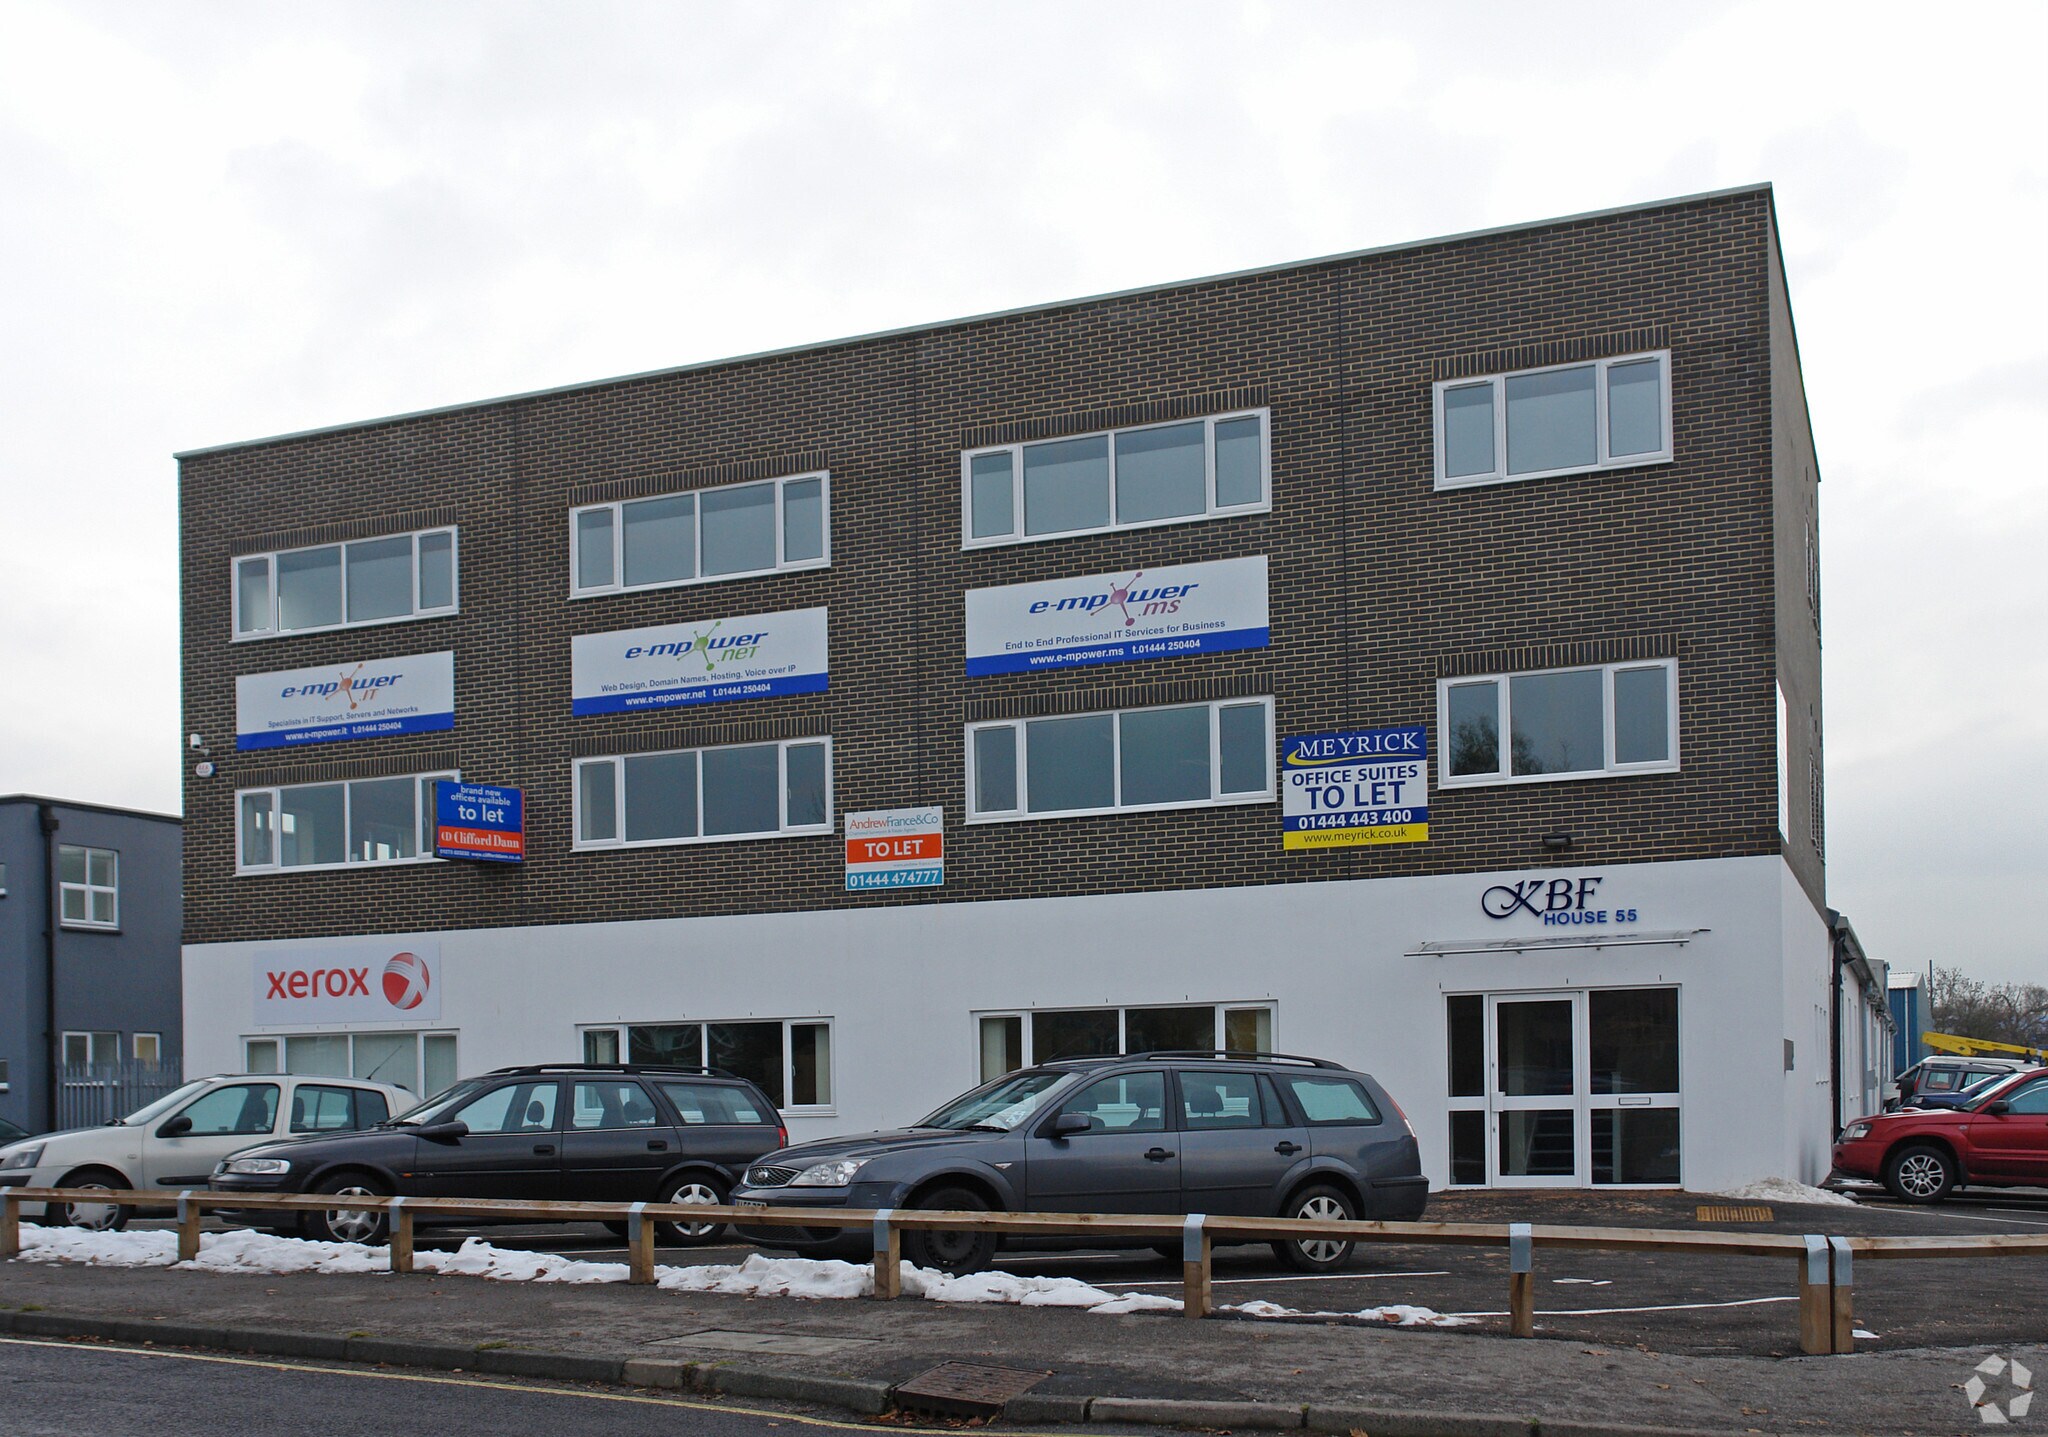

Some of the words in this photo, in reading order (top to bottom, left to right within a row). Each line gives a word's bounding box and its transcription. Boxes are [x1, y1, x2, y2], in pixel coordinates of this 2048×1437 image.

[1005, 641, 1023, 650] End
[1024, 640, 1034, 648] to
[1036, 638, 1054, 647] End
[1056, 631, 1113, 645] Professional
[1114, 630, 1123, 639] IT
[1125, 626, 1165, 638] Services
[1166, 624, 1181, 633] for
[1182, 619, 1226, 631] Business
[1029, 647, 1125, 665] www.e-mpower.ms
[1132, 641, 1166, 654] t.01444
[1167, 638, 1201, 650] 250404
[601, 683, 618, 693] Web
[619, 680, 648, 691] Design,
[649, 677, 679, 687] Domain
[680, 674, 709, 684] Names,
[710, 671, 744, 683] Hosting,
[744, 668, 767, 678] Voice
[768, 666, 787, 674] over
[787, 664, 797, 673] IP
[625, 689, 707, 706] www.e-mpower.net
[743, 683, 771, 694] 250404
[268, 719, 302, 729] Specialists
[346, 711, 371, 720] Servers
[373, 709, 386, 717] and
[387, 706, 418, 716] Networks
[1298, 731, 1420, 758] MEYRICK
[1292, 769, 1352, 786] OFFICE
[1358, 764, 1418, 782] SUITES
[450, 792, 476, 802] offices
[477, 796, 511, 806] available
[460, 785, 483, 795] brand
[485, 789, 502, 797] new
[1305, 785, 1345, 810] TO
[1354, 781, 1406, 807] LET
[458, 804, 477, 820] to
[482, 804, 504, 823] let
[1298, 813, 1347, 830] 01444
[1350, 811, 1378, 826] 443
[1382, 809, 1412, 823] 400
[453, 831, 492, 846] Clifford
[493, 834, 519, 848] Dann
[1304, 827, 1407, 843] www.meyrick.co.uk
[864, 842, 890, 858] TO
[894, 839, 924, 856] LET
[850, 873, 889, 887] 01444
[891, 870, 940, 885] 474777
[1481, 877, 1603, 919] KBF
[1544, 910, 1608, 926] HOUSE
[1615, 909, 1638, 923] 55
[266, 967, 370, 1000] xerox
